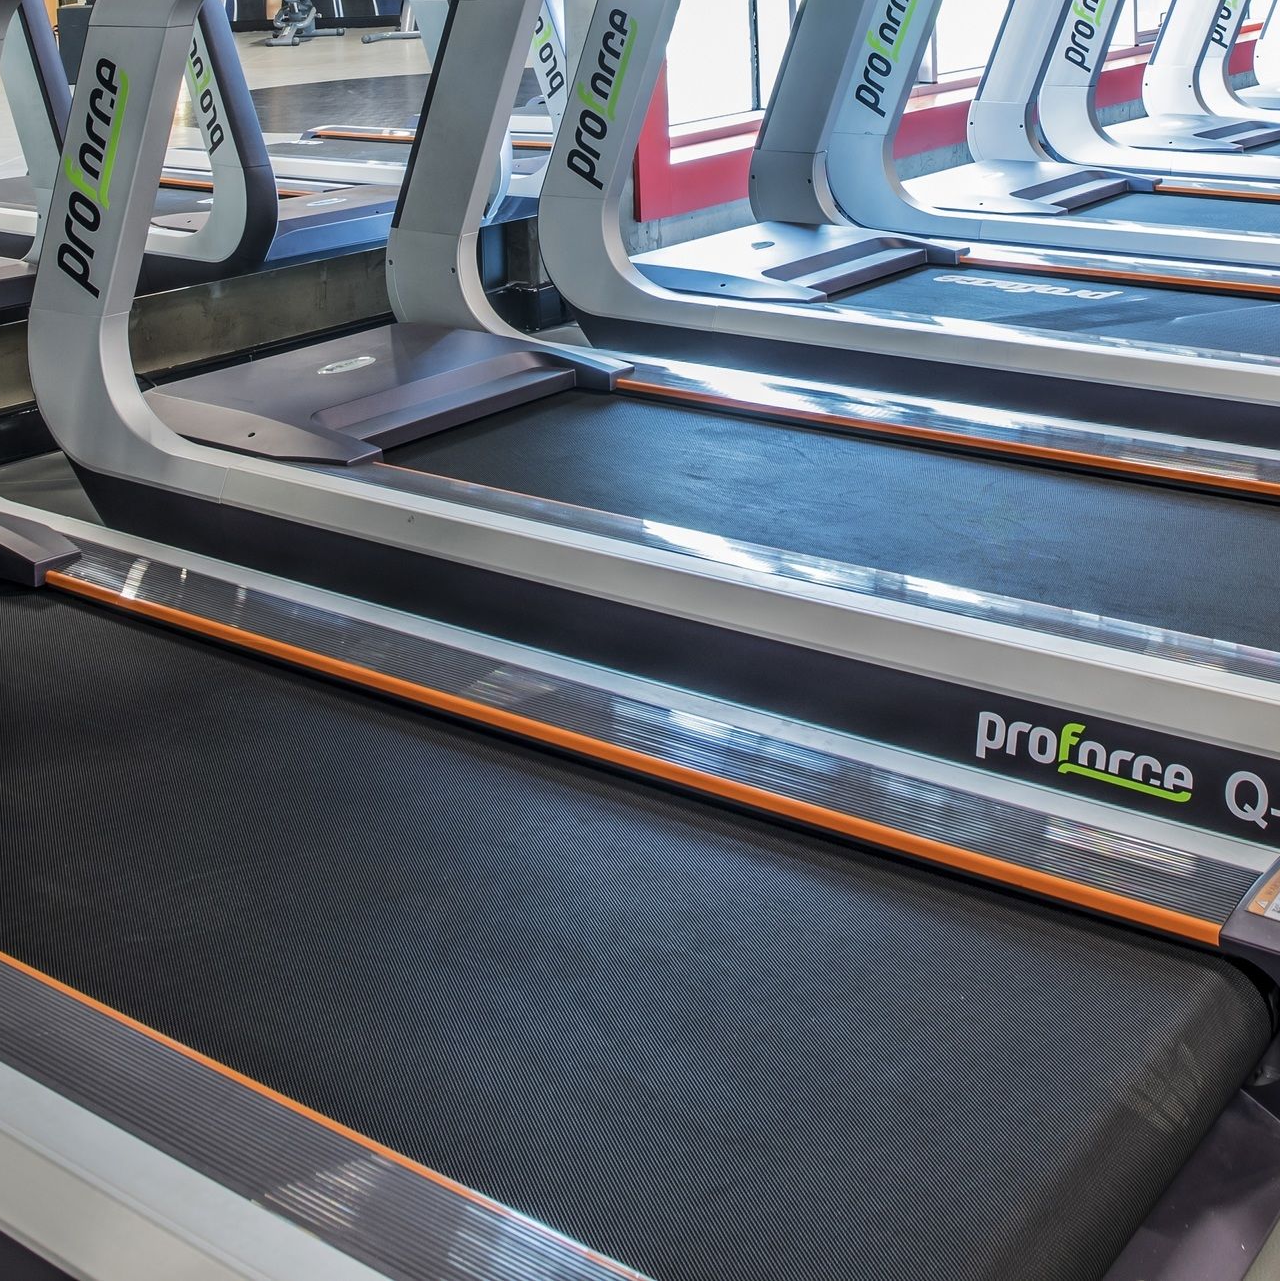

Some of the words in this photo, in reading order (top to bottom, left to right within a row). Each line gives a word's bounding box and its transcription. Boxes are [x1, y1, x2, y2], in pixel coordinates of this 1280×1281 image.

[57, 57, 129, 299] proforce
[566, 8, 638, 190] proforce
[975, 710, 1194, 804] proforce
